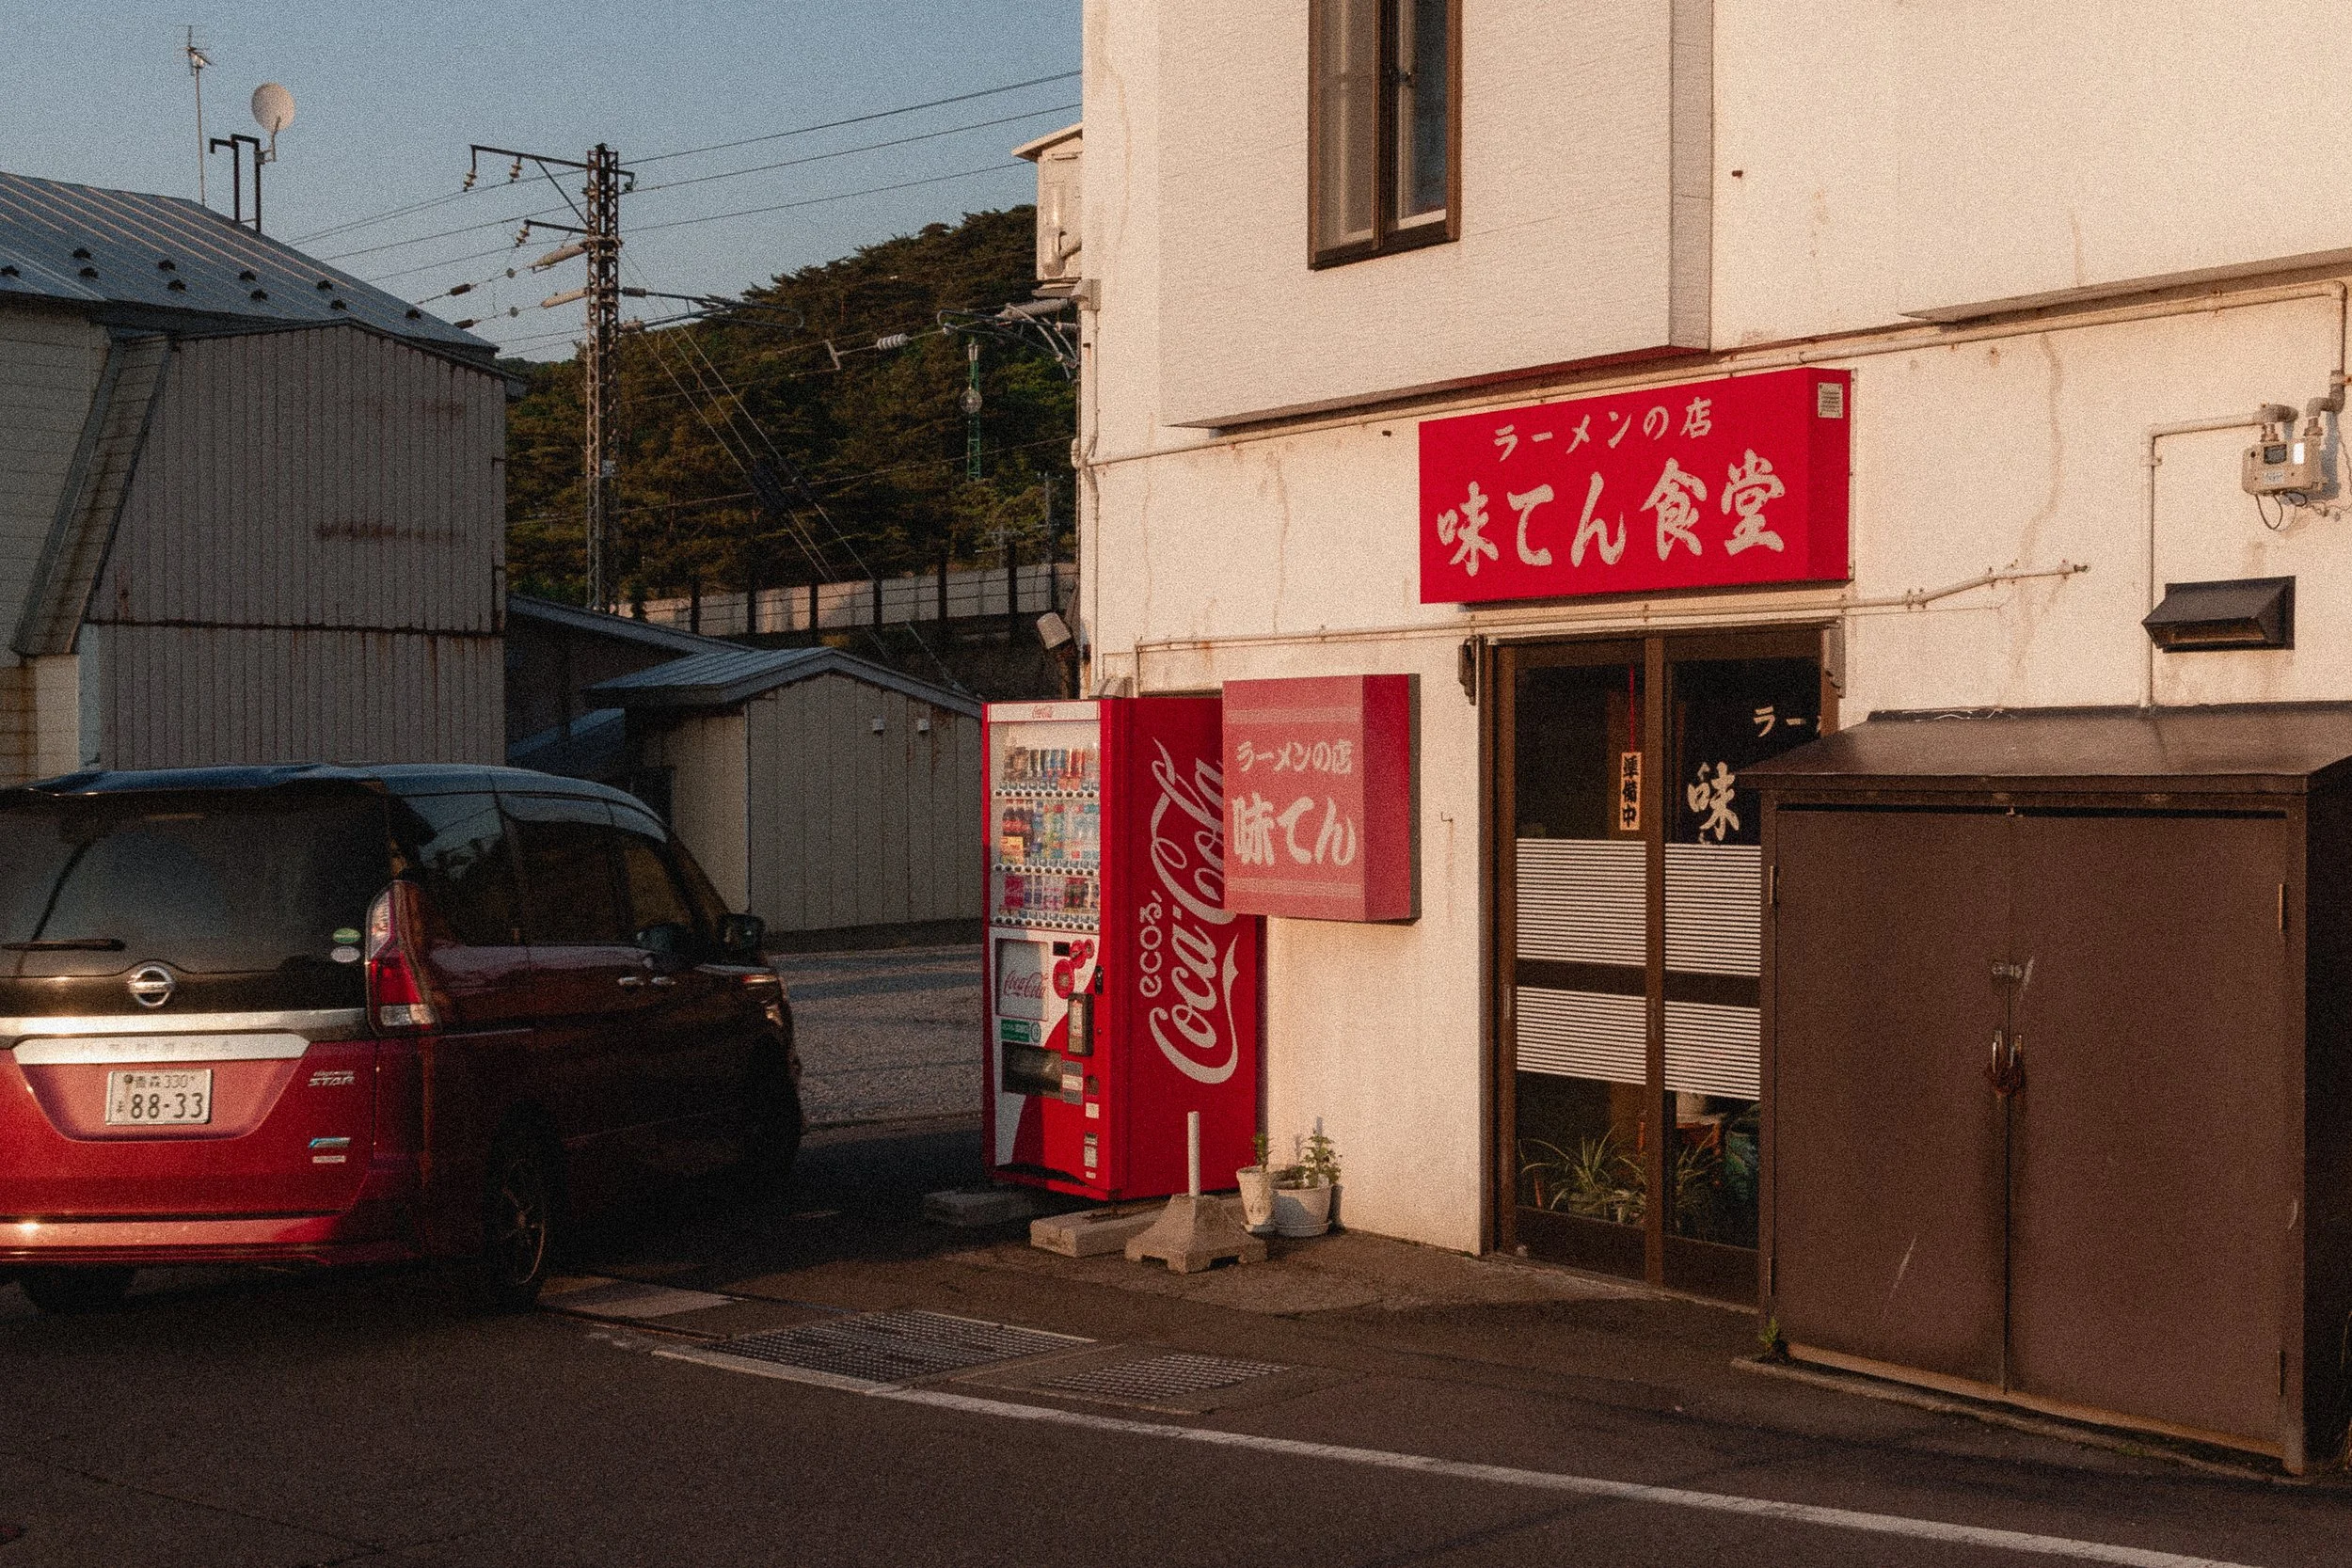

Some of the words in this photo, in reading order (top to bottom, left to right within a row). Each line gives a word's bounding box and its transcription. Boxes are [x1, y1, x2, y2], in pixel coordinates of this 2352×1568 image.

[1492, 396, 1713, 462] ラーメンの店
[1437, 449, 1786, 577] 味てん食堂
[1753, 705, 1821, 737] ラー
[1235, 740, 1353, 774] ラーメンの店
[1623, 755, 1638, 828] 準備中
[1687, 761, 1740, 841] 味
[1231, 791, 1357, 866] 味てん
[131, 1092, 203, 1118] 88-33
[308, 1077, 355, 1086] STAR
